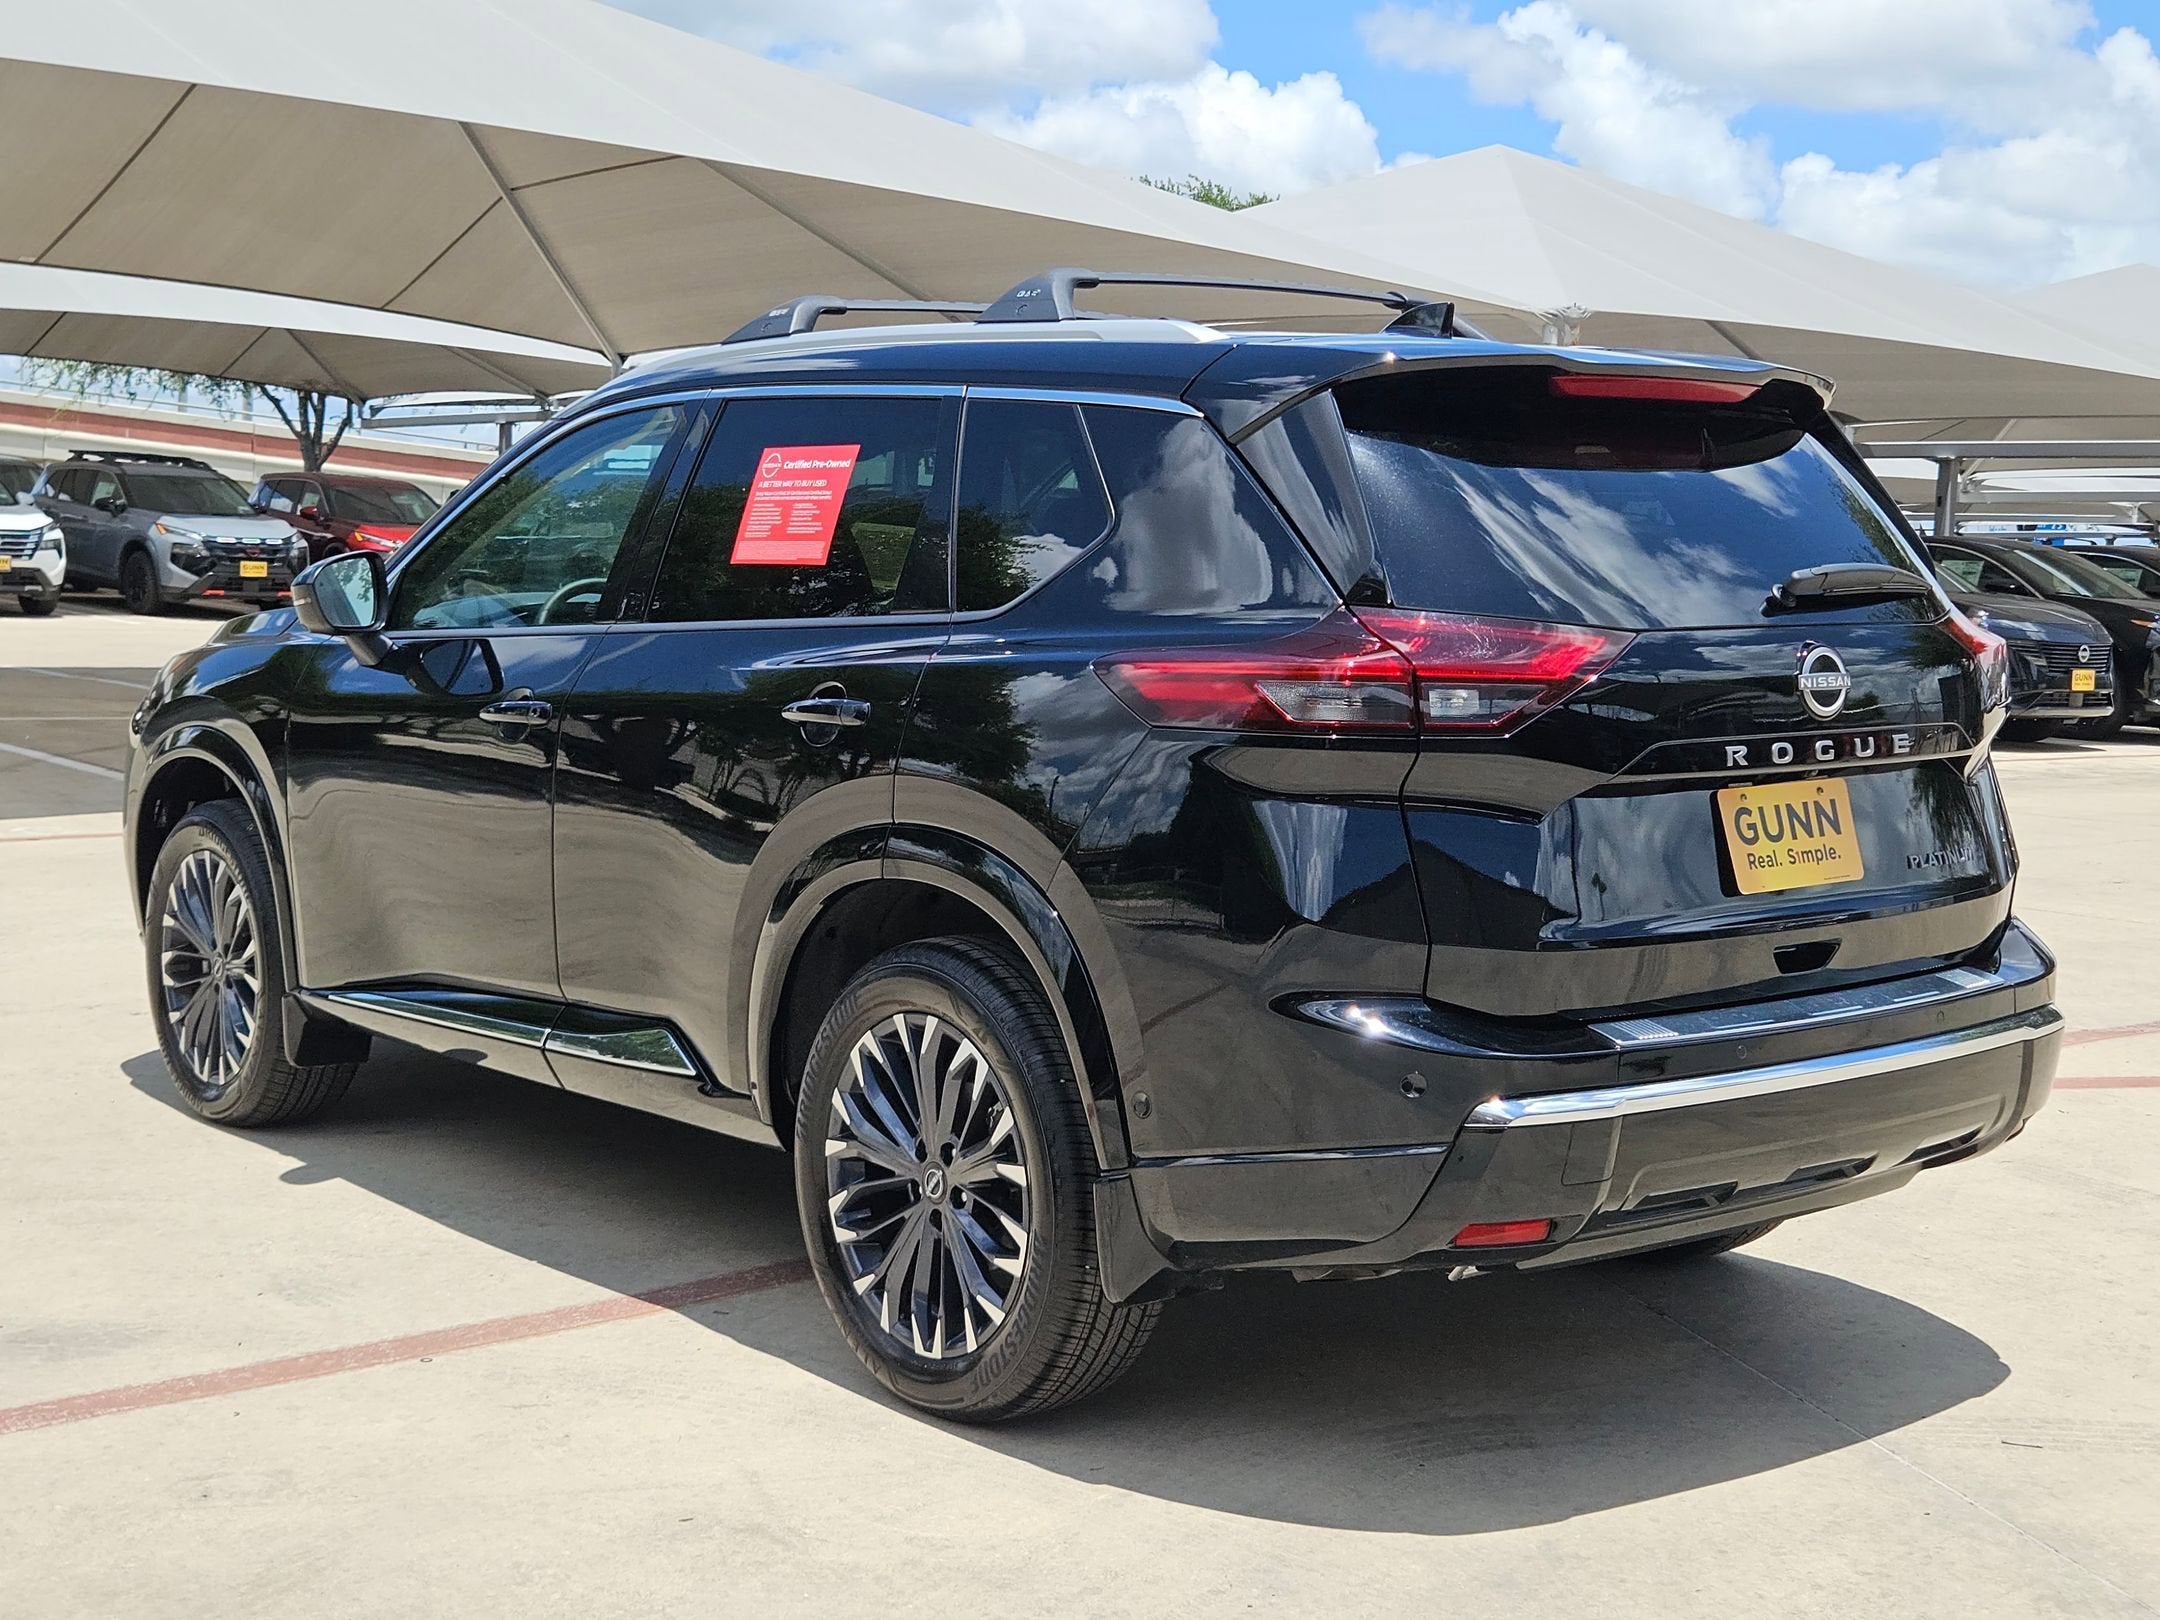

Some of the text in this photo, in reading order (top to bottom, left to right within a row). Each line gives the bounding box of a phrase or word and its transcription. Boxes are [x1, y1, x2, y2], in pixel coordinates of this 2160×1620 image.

[784, 459, 851, 469] Certified Pre-Owned
[1800, 676, 1851, 688] NISSAN
[1725, 733, 1914, 767] ROGUE
[1734, 798, 1843, 846] GUNN
[1746, 844, 1842, 870] Real. Simple.
